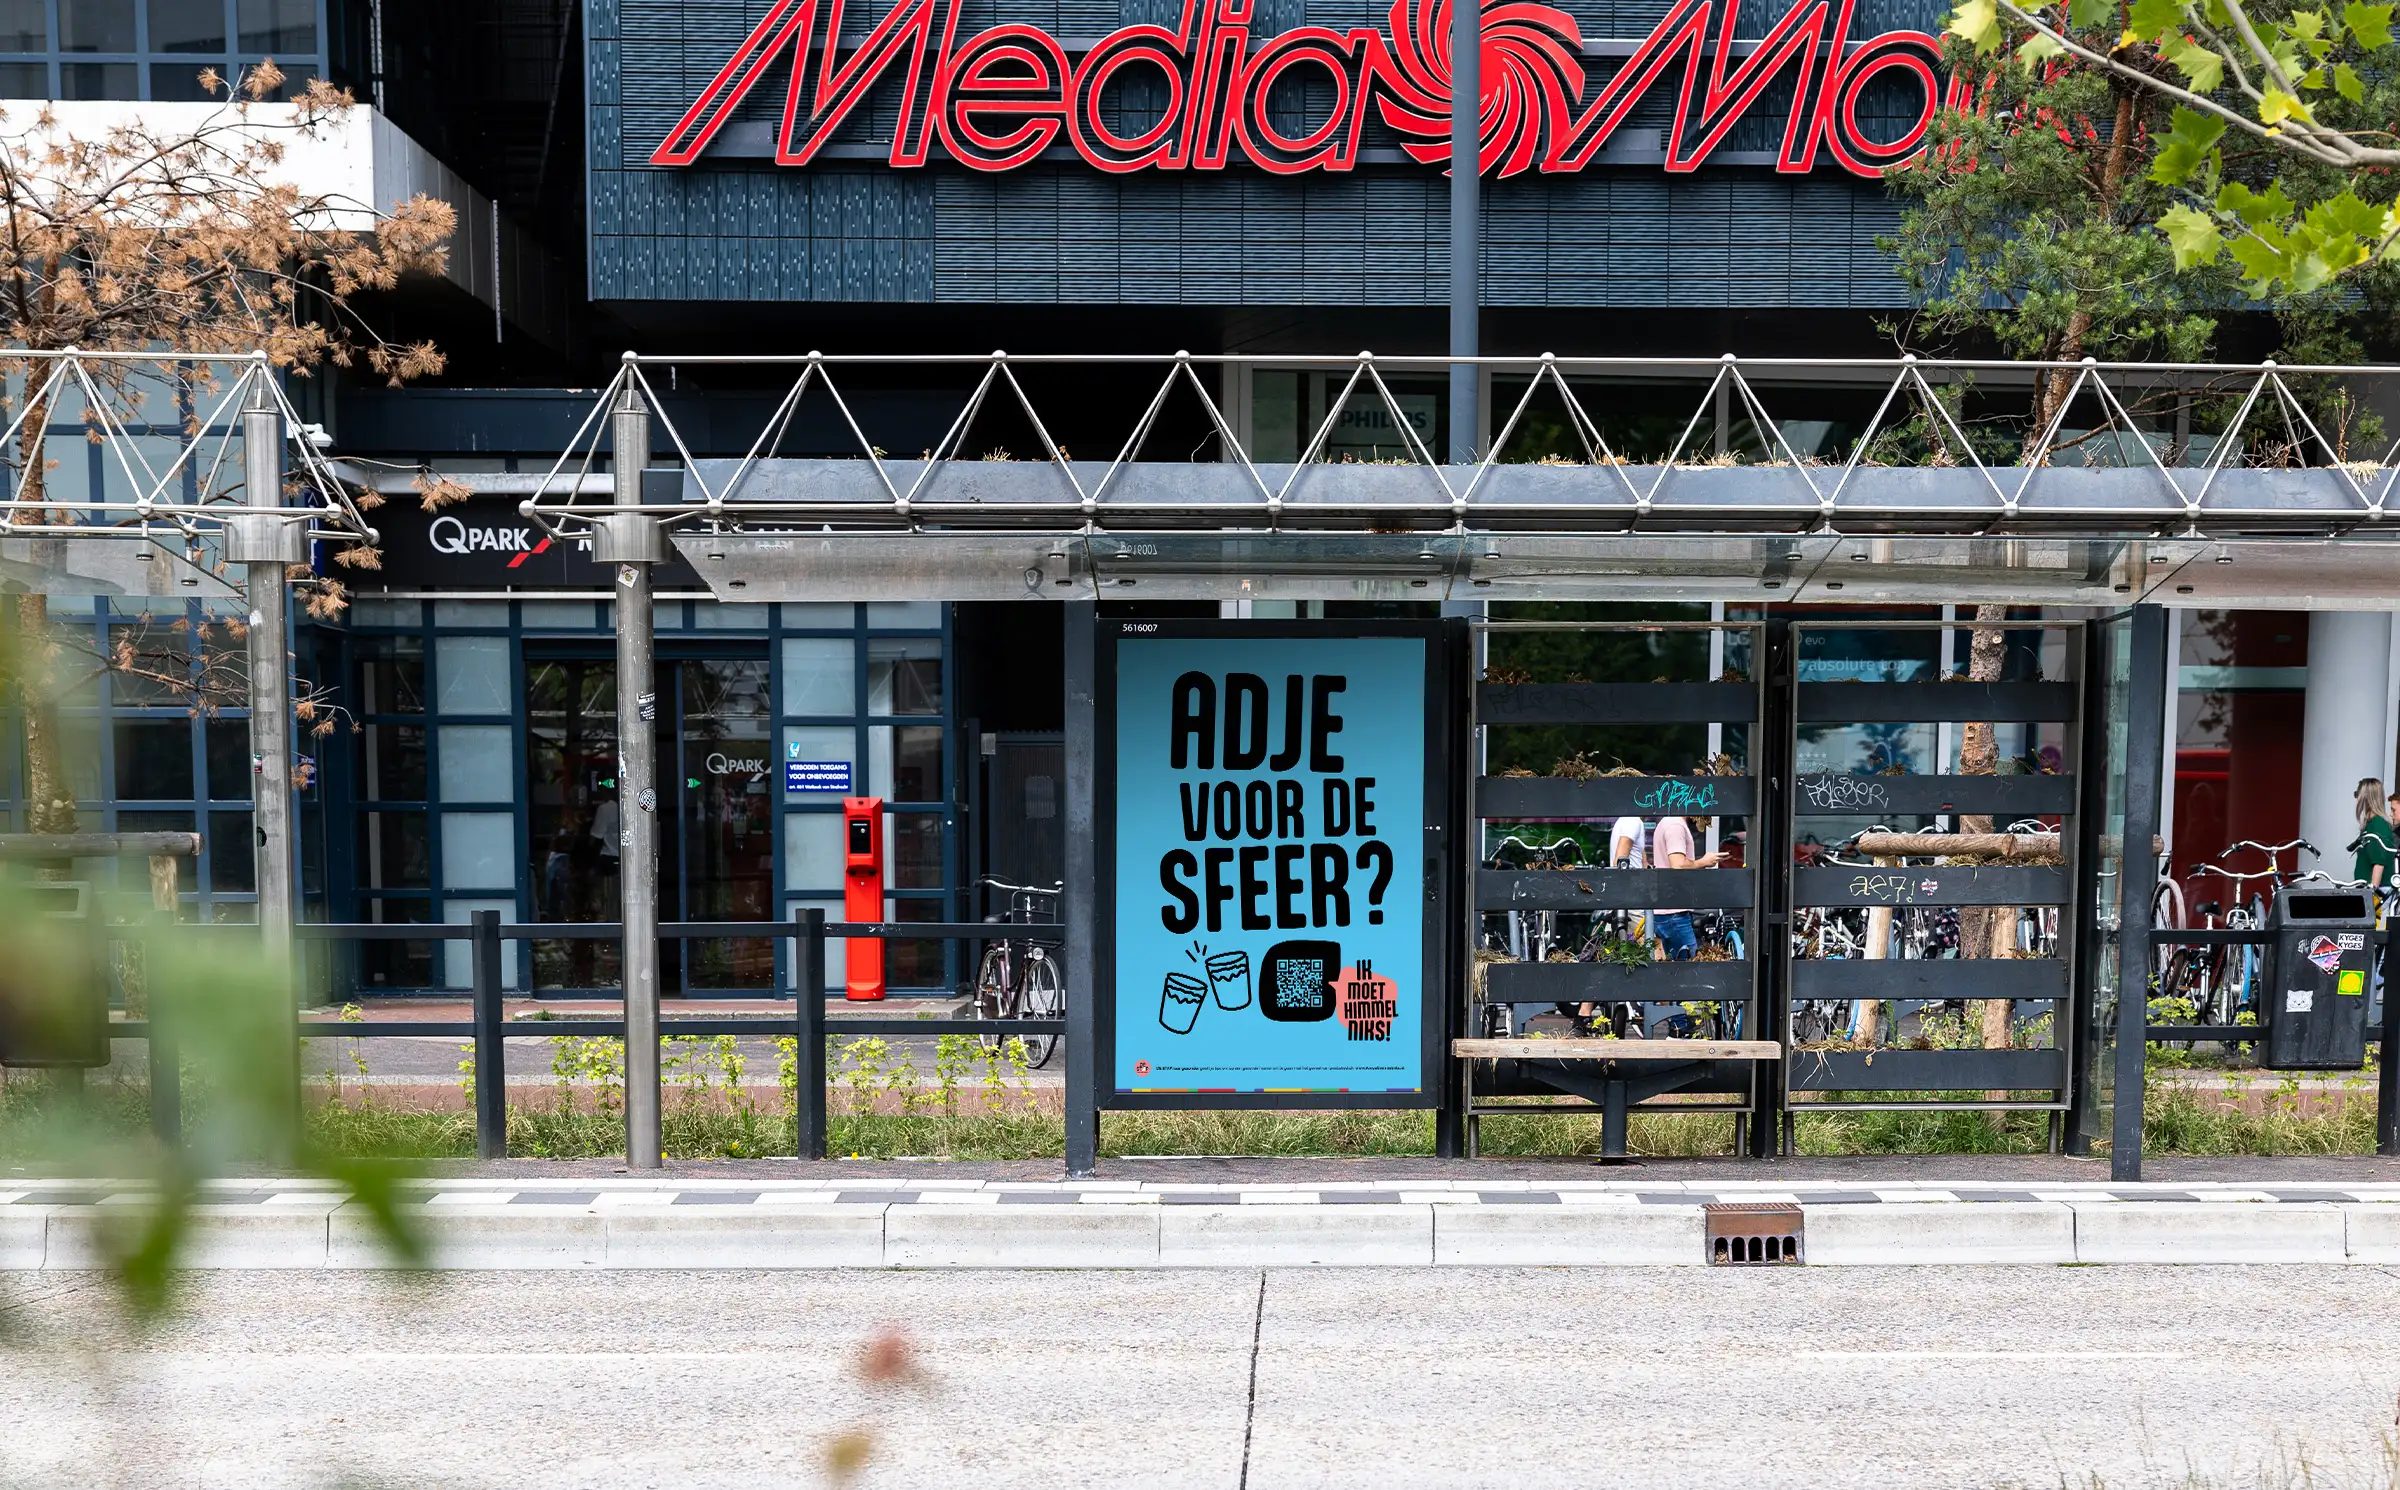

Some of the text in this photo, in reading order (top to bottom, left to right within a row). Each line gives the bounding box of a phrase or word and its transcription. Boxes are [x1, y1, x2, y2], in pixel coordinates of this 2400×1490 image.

[1122, 623, 1158, 632] 5616007
[1805, 636, 1826, 645] evo
[1808, 656, 1875, 672] absolute
[1170, 671, 1347, 773] ADJE
[1179, 777, 1377, 842] VOOR DE
[1159, 840, 1394, 934] SFEER?
[1356, 959, 1372, 980] IK
[1348, 982, 1386, 1000] MOET
[1344, 1000, 1399, 1019] HIMMEL
[1348, 1020, 1391, 1042] NIKS!
